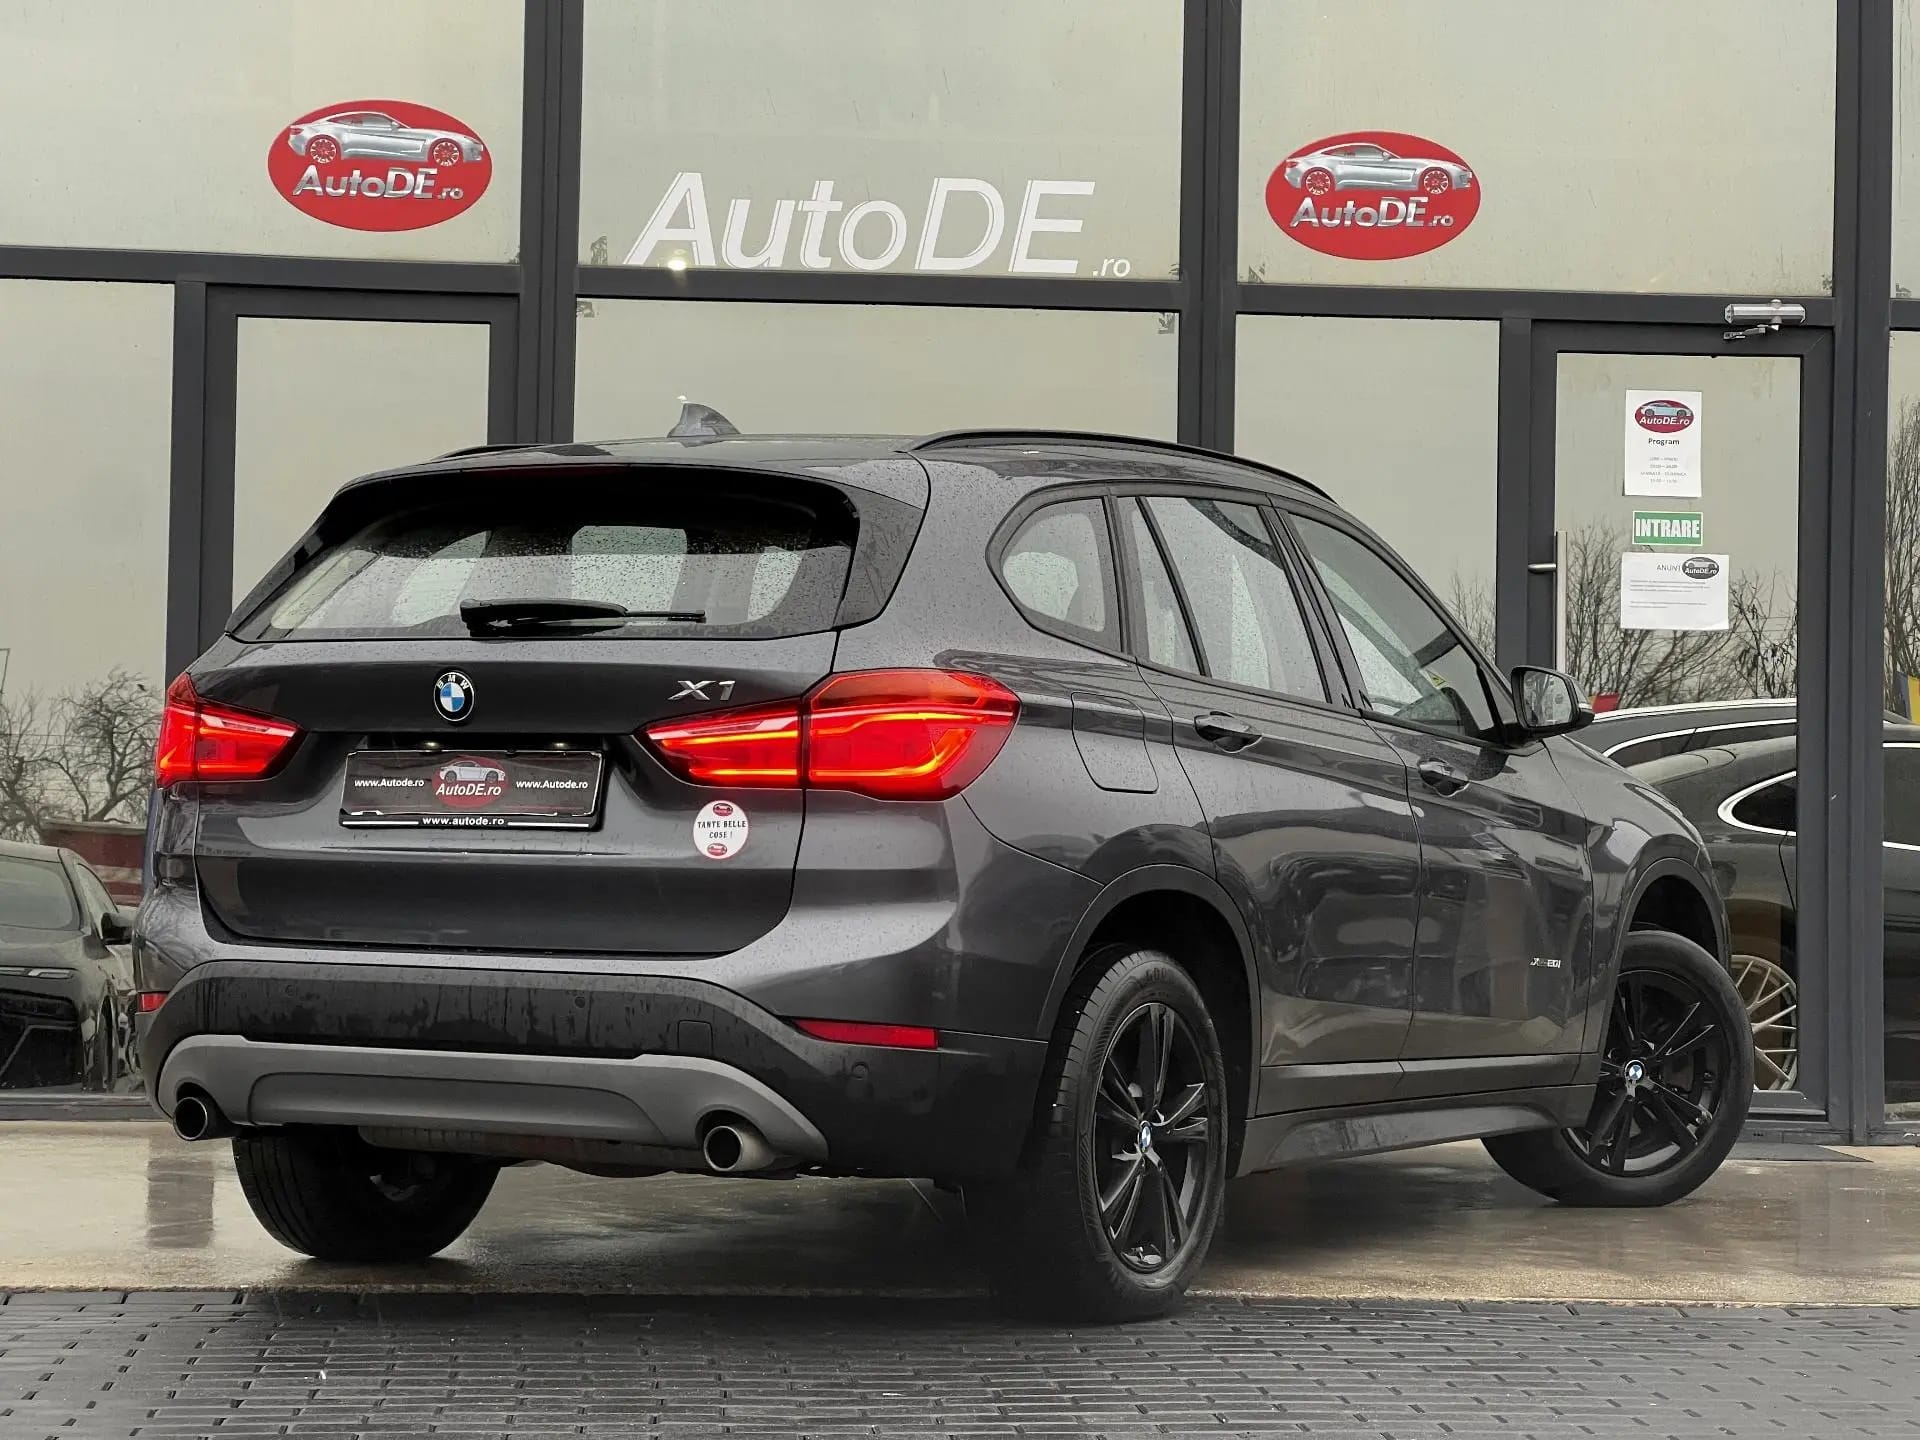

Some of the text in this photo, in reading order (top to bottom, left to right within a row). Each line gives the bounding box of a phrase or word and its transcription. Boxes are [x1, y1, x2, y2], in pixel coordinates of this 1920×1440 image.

[1639, 416, 1690, 426] AutoDE.ro
[1648, 437, 1680, 446] Program
[1635, 518, 1700, 538] INTRARE
[436, 674, 470, 690] BMW
[667, 680, 736, 701] X1
[354, 778, 425, 787] www.Autode.ro
[516, 780, 589, 789] www.Autode.ro
[435, 783, 502, 796] AutoDE.ro
[422, 816, 505, 826] www.autode.ro
[697, 820, 747, 828] TANTE BELLE
